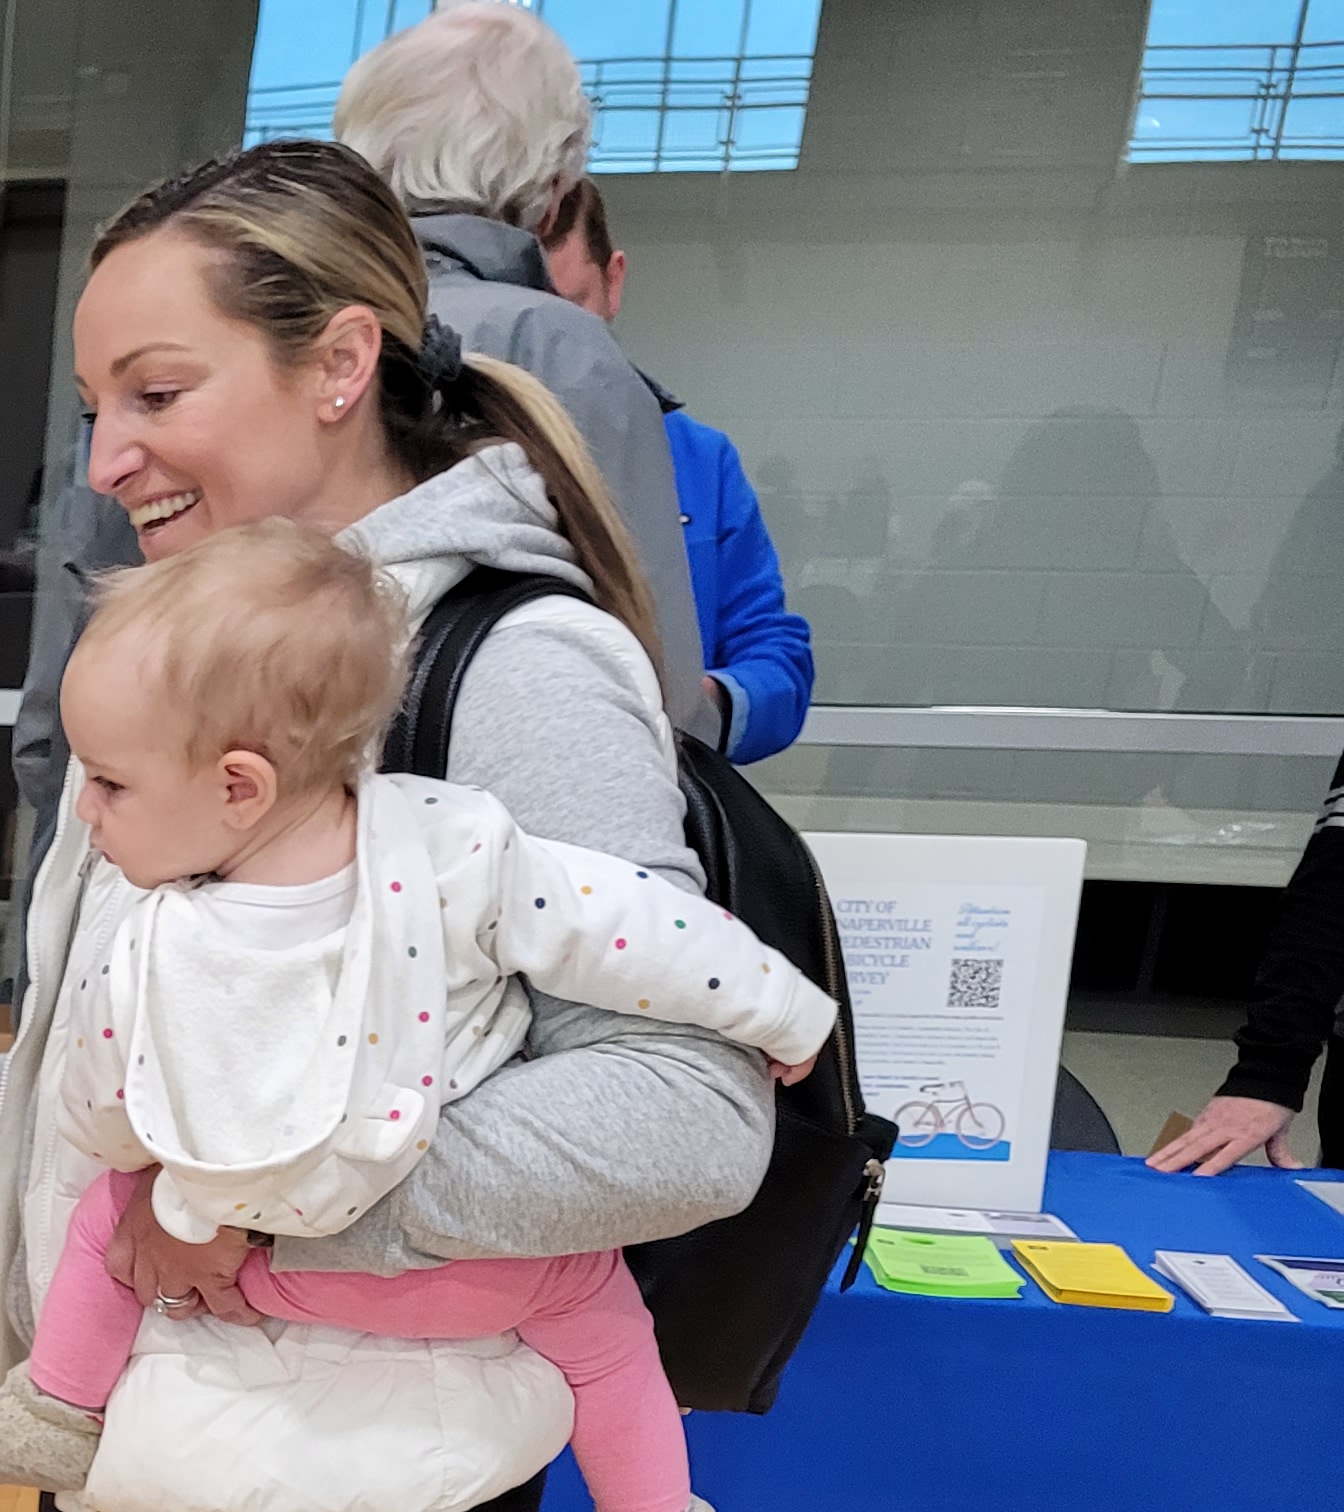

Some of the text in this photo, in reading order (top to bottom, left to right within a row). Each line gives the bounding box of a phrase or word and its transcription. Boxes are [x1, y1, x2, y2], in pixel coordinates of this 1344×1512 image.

[837, 899, 897, 913] CITY OF
[837, 917, 932, 932] NAPERVILLE
[842, 936, 931, 950] EDESTRIAN
[848, 971, 890, 985] RVEY
